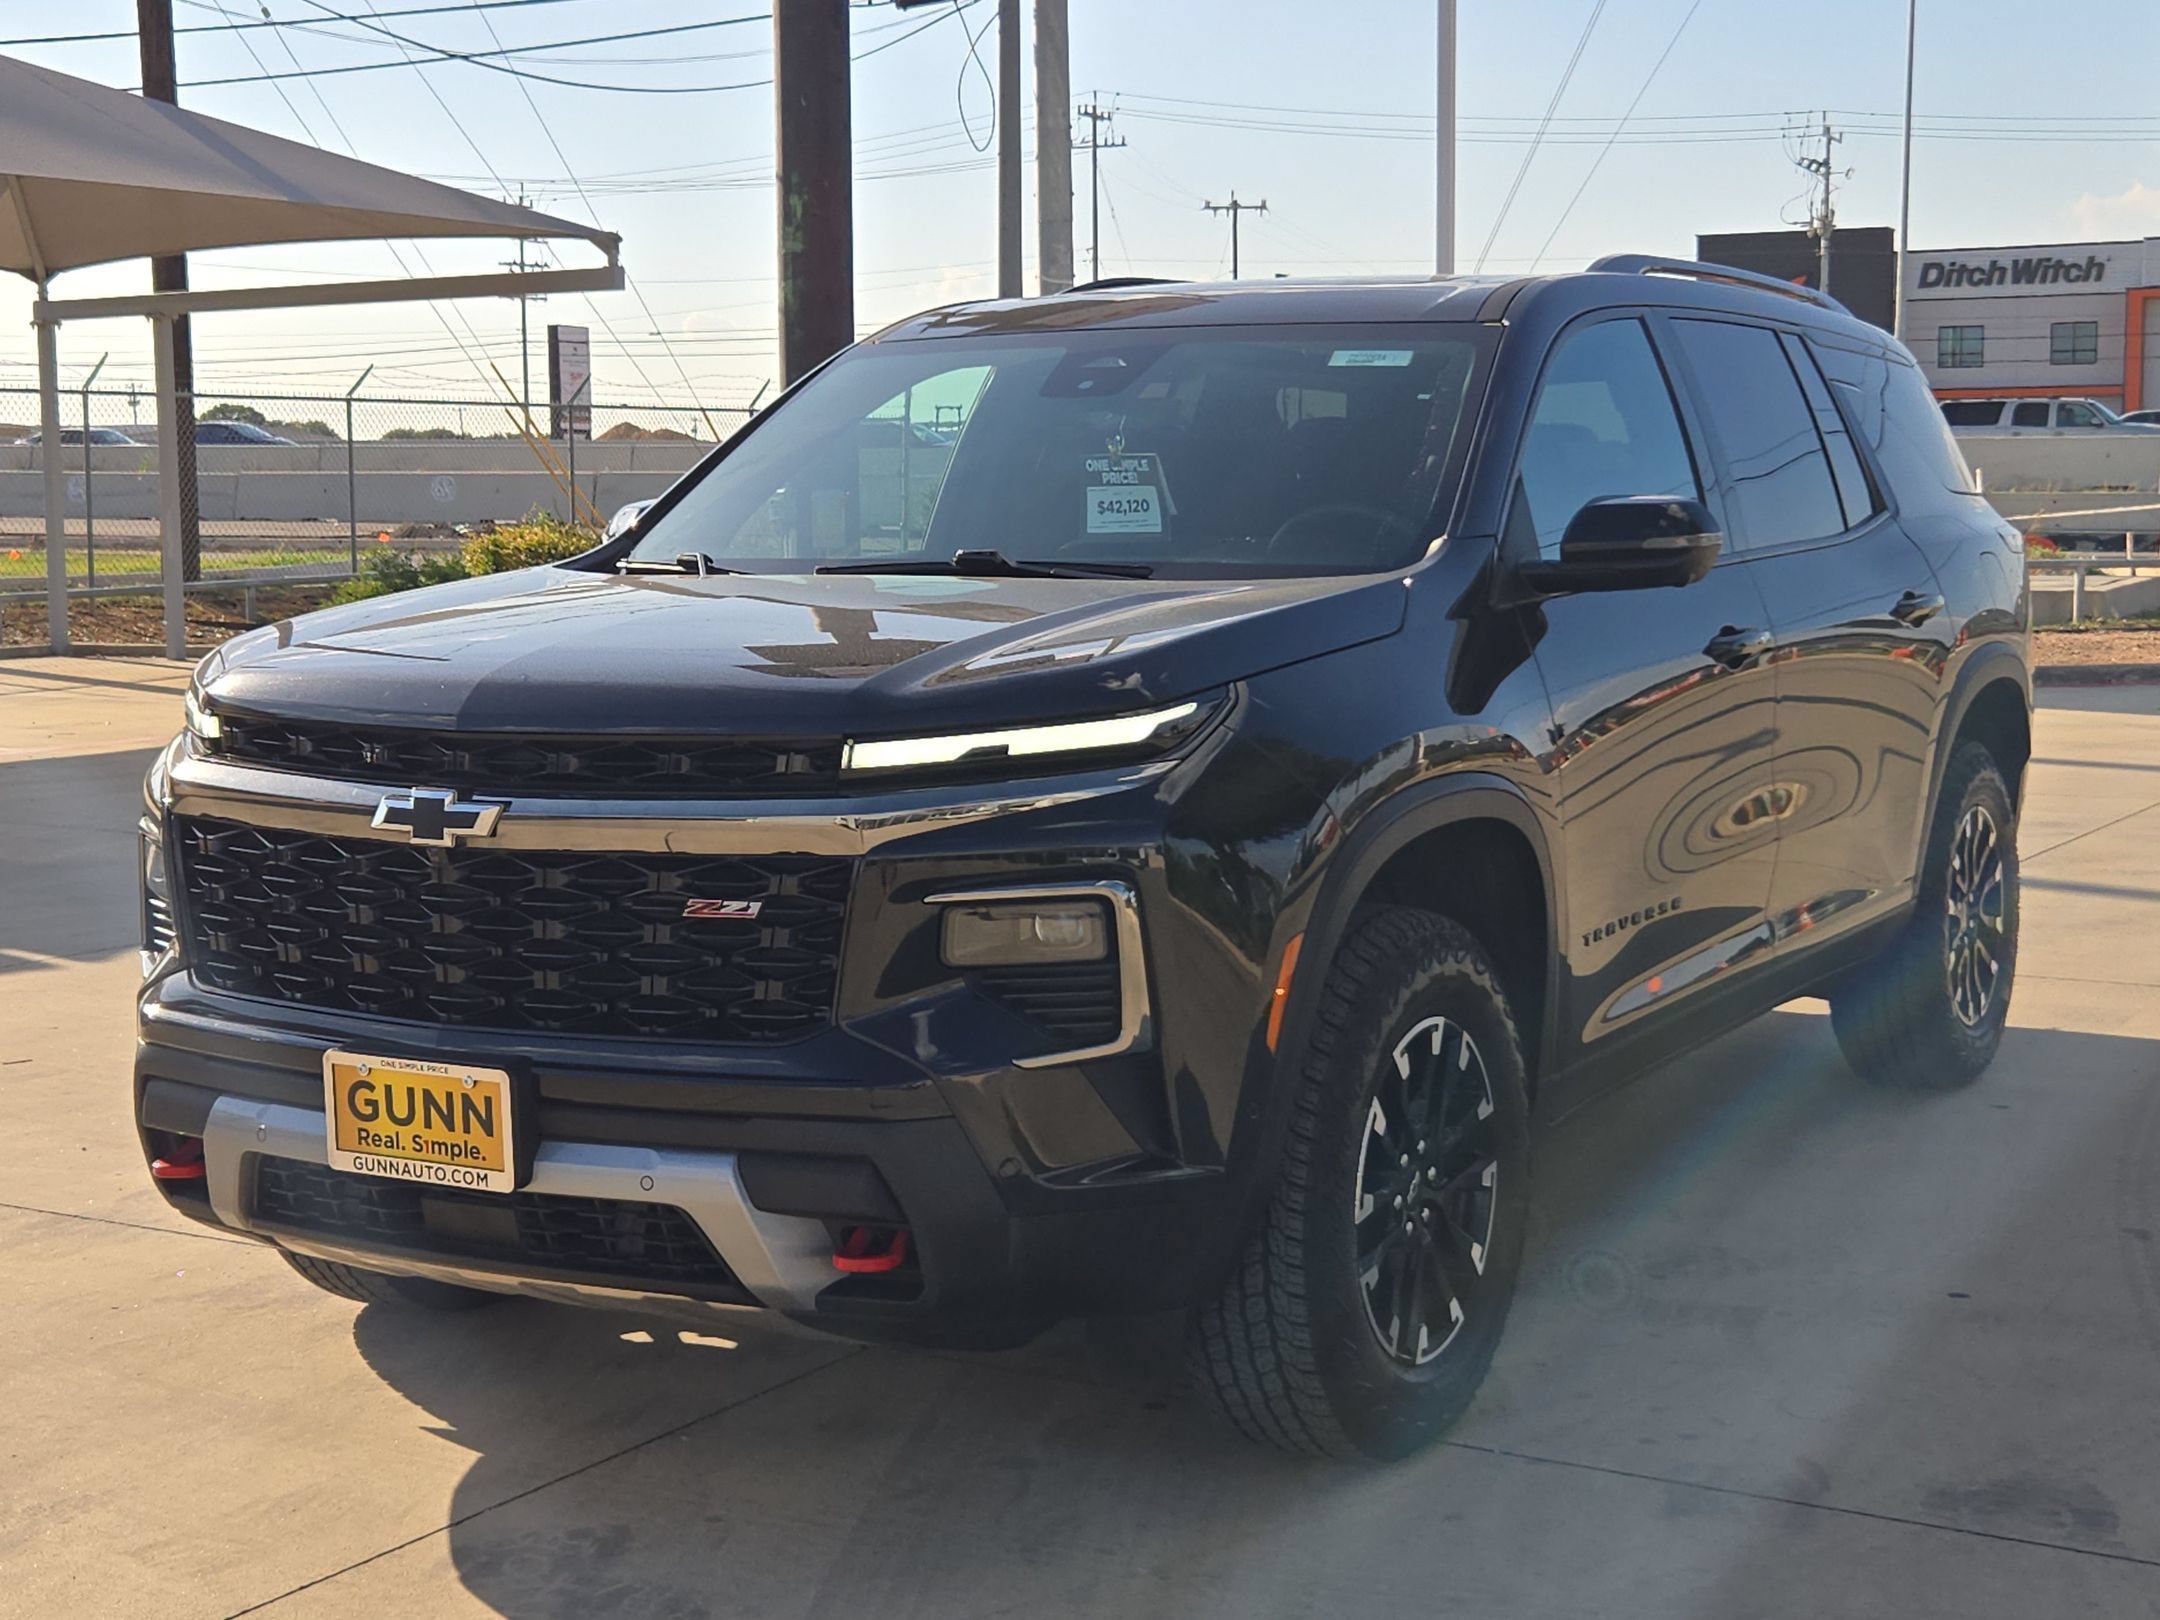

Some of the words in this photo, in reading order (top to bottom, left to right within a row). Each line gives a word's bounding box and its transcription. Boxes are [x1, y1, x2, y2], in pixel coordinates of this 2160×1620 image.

[1918, 260, 2007, 289] Ditch
[2011, 255, 2106, 285] Witch
[1086, 459, 1109, 472] ONE
[1110, 459, 1150, 471] MPLE
[1097, 499, 1150, 516] $42,120
[682, 899, 762, 918] Z71
[1582, 896, 1682, 947] TRAVERSE
[381, 1060, 396, 1069] ONE
[398, 1062, 425, 1072] SIMPLE
[427, 1064, 449, 1075] PRICE
[347, 1080, 494, 1137] GUNN
[358, 1127, 405, 1151] Real.
[353, 1156, 489, 1187] GUNNAUTO.COM
